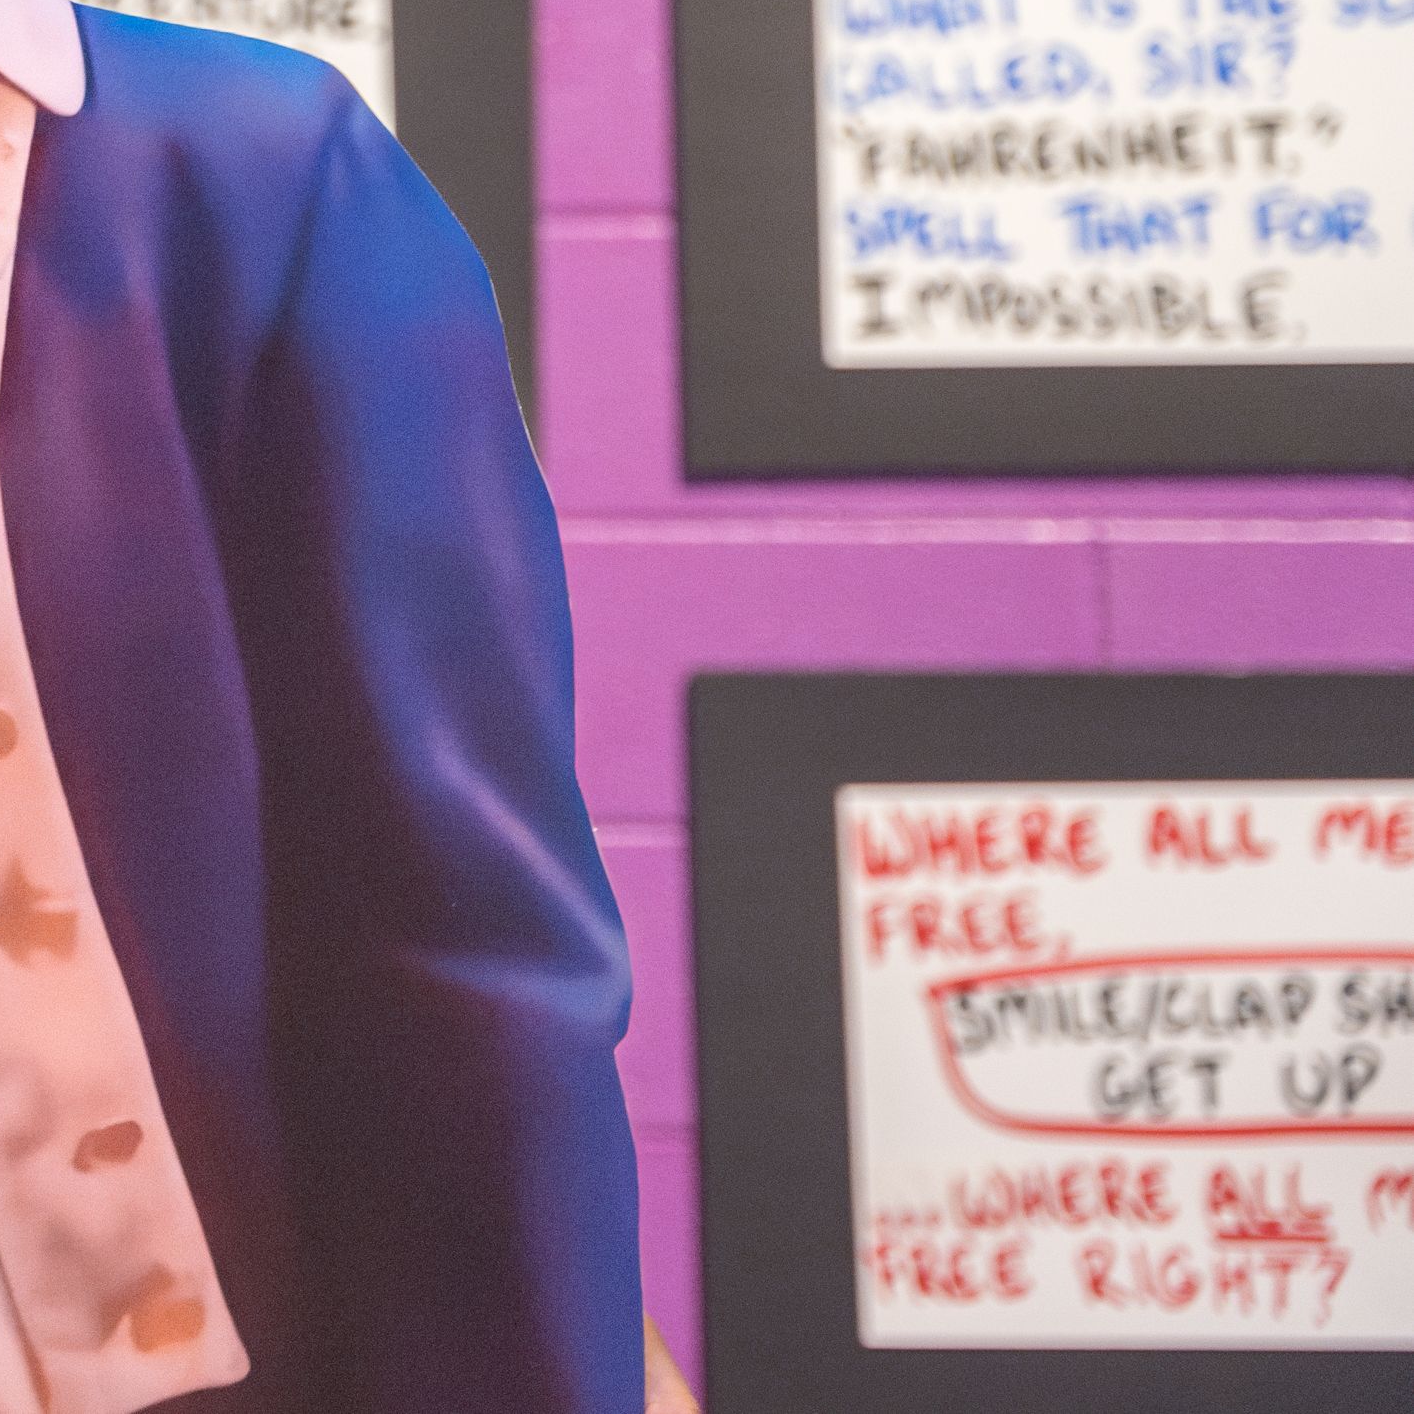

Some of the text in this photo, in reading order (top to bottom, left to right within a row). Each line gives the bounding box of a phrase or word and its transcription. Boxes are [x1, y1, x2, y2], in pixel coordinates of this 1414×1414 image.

[1146, 25, 1298, 100] SIR?
[1057, 187, 1225, 257] THAT
[1253, 183, 1380, 257] FOR
[857, 804, 1108, 875] WHERE
[1145, 804, 1273, 872] ALL
[866, 888, 1073, 964] FREE,
[952, 969, 1316, 1055] SMILE/CLAP
[1092, 1042, 1382, 1122] GET UP
[1207, 1158, 1331, 1224] ALL
[872, 1238, 1352, 1325] FREE RIGHT?
